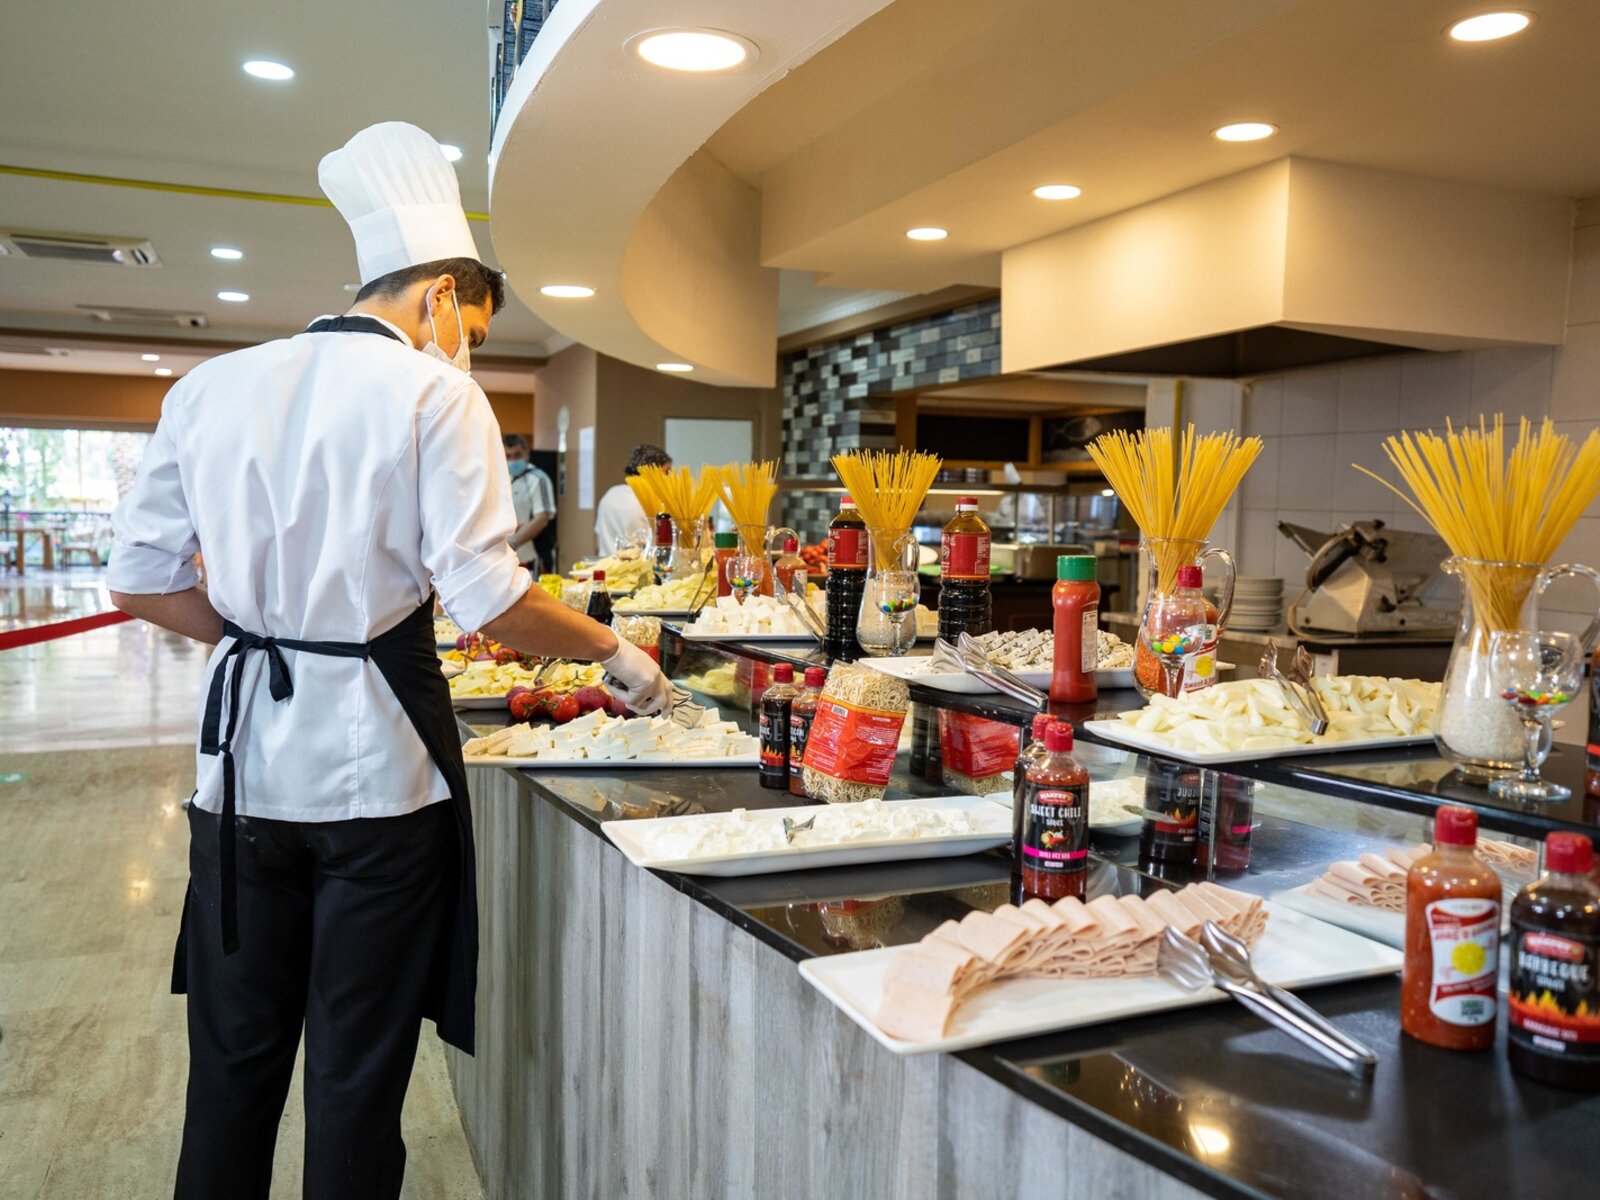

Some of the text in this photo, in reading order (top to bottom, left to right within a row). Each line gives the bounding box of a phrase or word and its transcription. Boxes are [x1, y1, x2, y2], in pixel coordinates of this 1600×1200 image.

[1031, 804, 1082, 818] SWEET CHILI
[1046, 818, 1064, 827] SAUCE
[1518, 950, 1589, 981] BARBECUE
